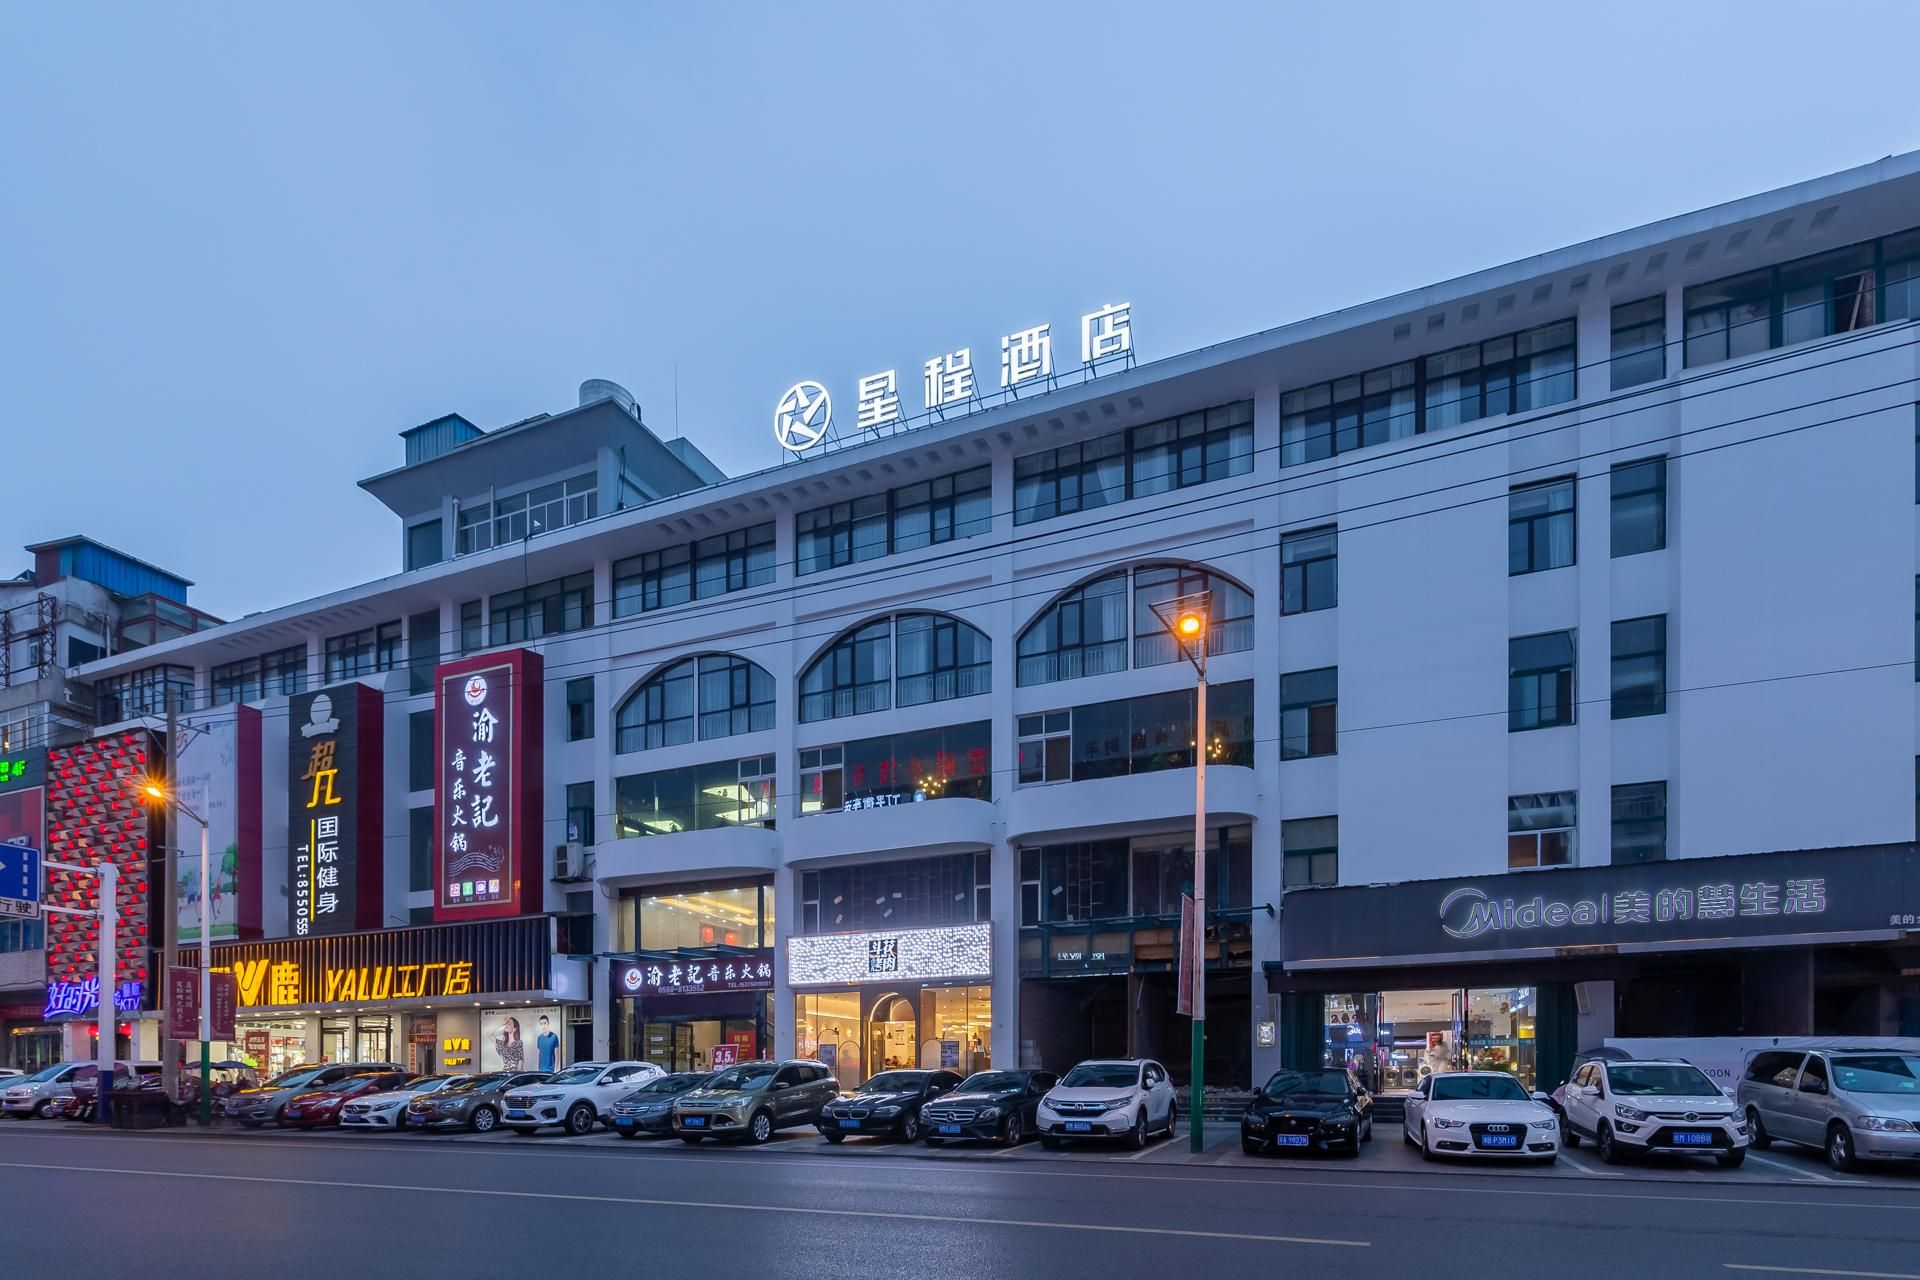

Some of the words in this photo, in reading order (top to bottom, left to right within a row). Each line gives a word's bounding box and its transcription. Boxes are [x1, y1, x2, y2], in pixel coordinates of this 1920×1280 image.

[857, 302, 1130, 428] 星程酒店
[301, 741, 342, 808] 超凡
[316, 816, 339, 914] 国际健身
[1449, 892, 1597, 935] Midea
[1614, 879, 1825, 924] 美的慧生活
[120, 997, 140, 1010] KTV
